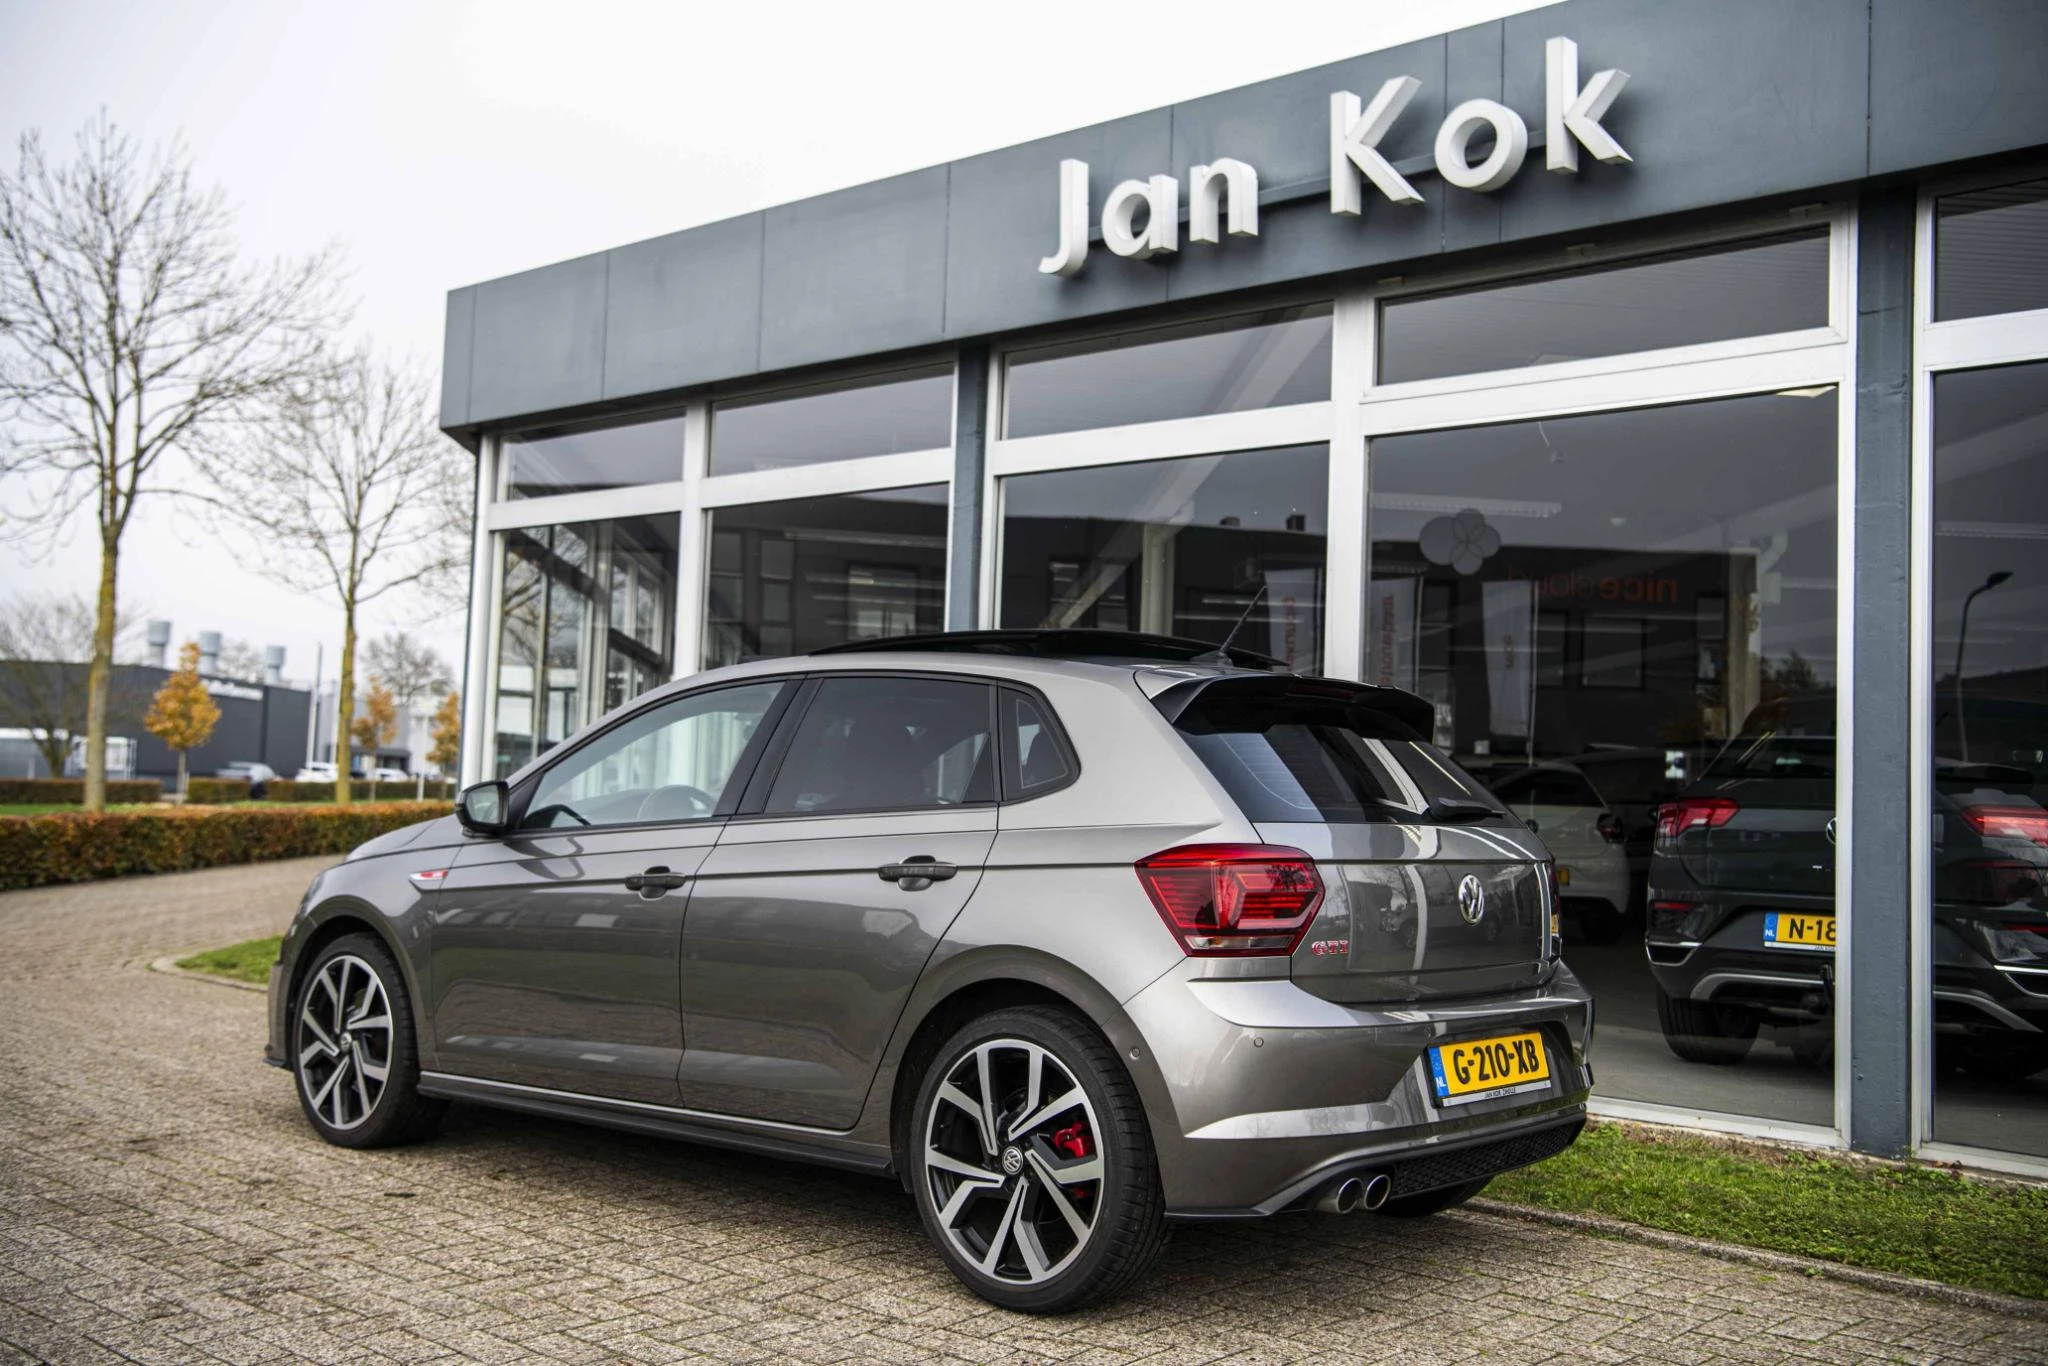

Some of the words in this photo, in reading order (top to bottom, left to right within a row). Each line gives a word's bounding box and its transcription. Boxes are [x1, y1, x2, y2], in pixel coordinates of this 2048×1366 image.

[1038, 157, 1258, 277] Jan
[1330, 36, 1634, 217] Kok
[1765, 929, 1775, 937] NL
[1311, 940, 1349, 956] GTI
[1453, 1039, 1540, 1085] G-210-XB
[1435, 1077, 1447, 1088] NL
